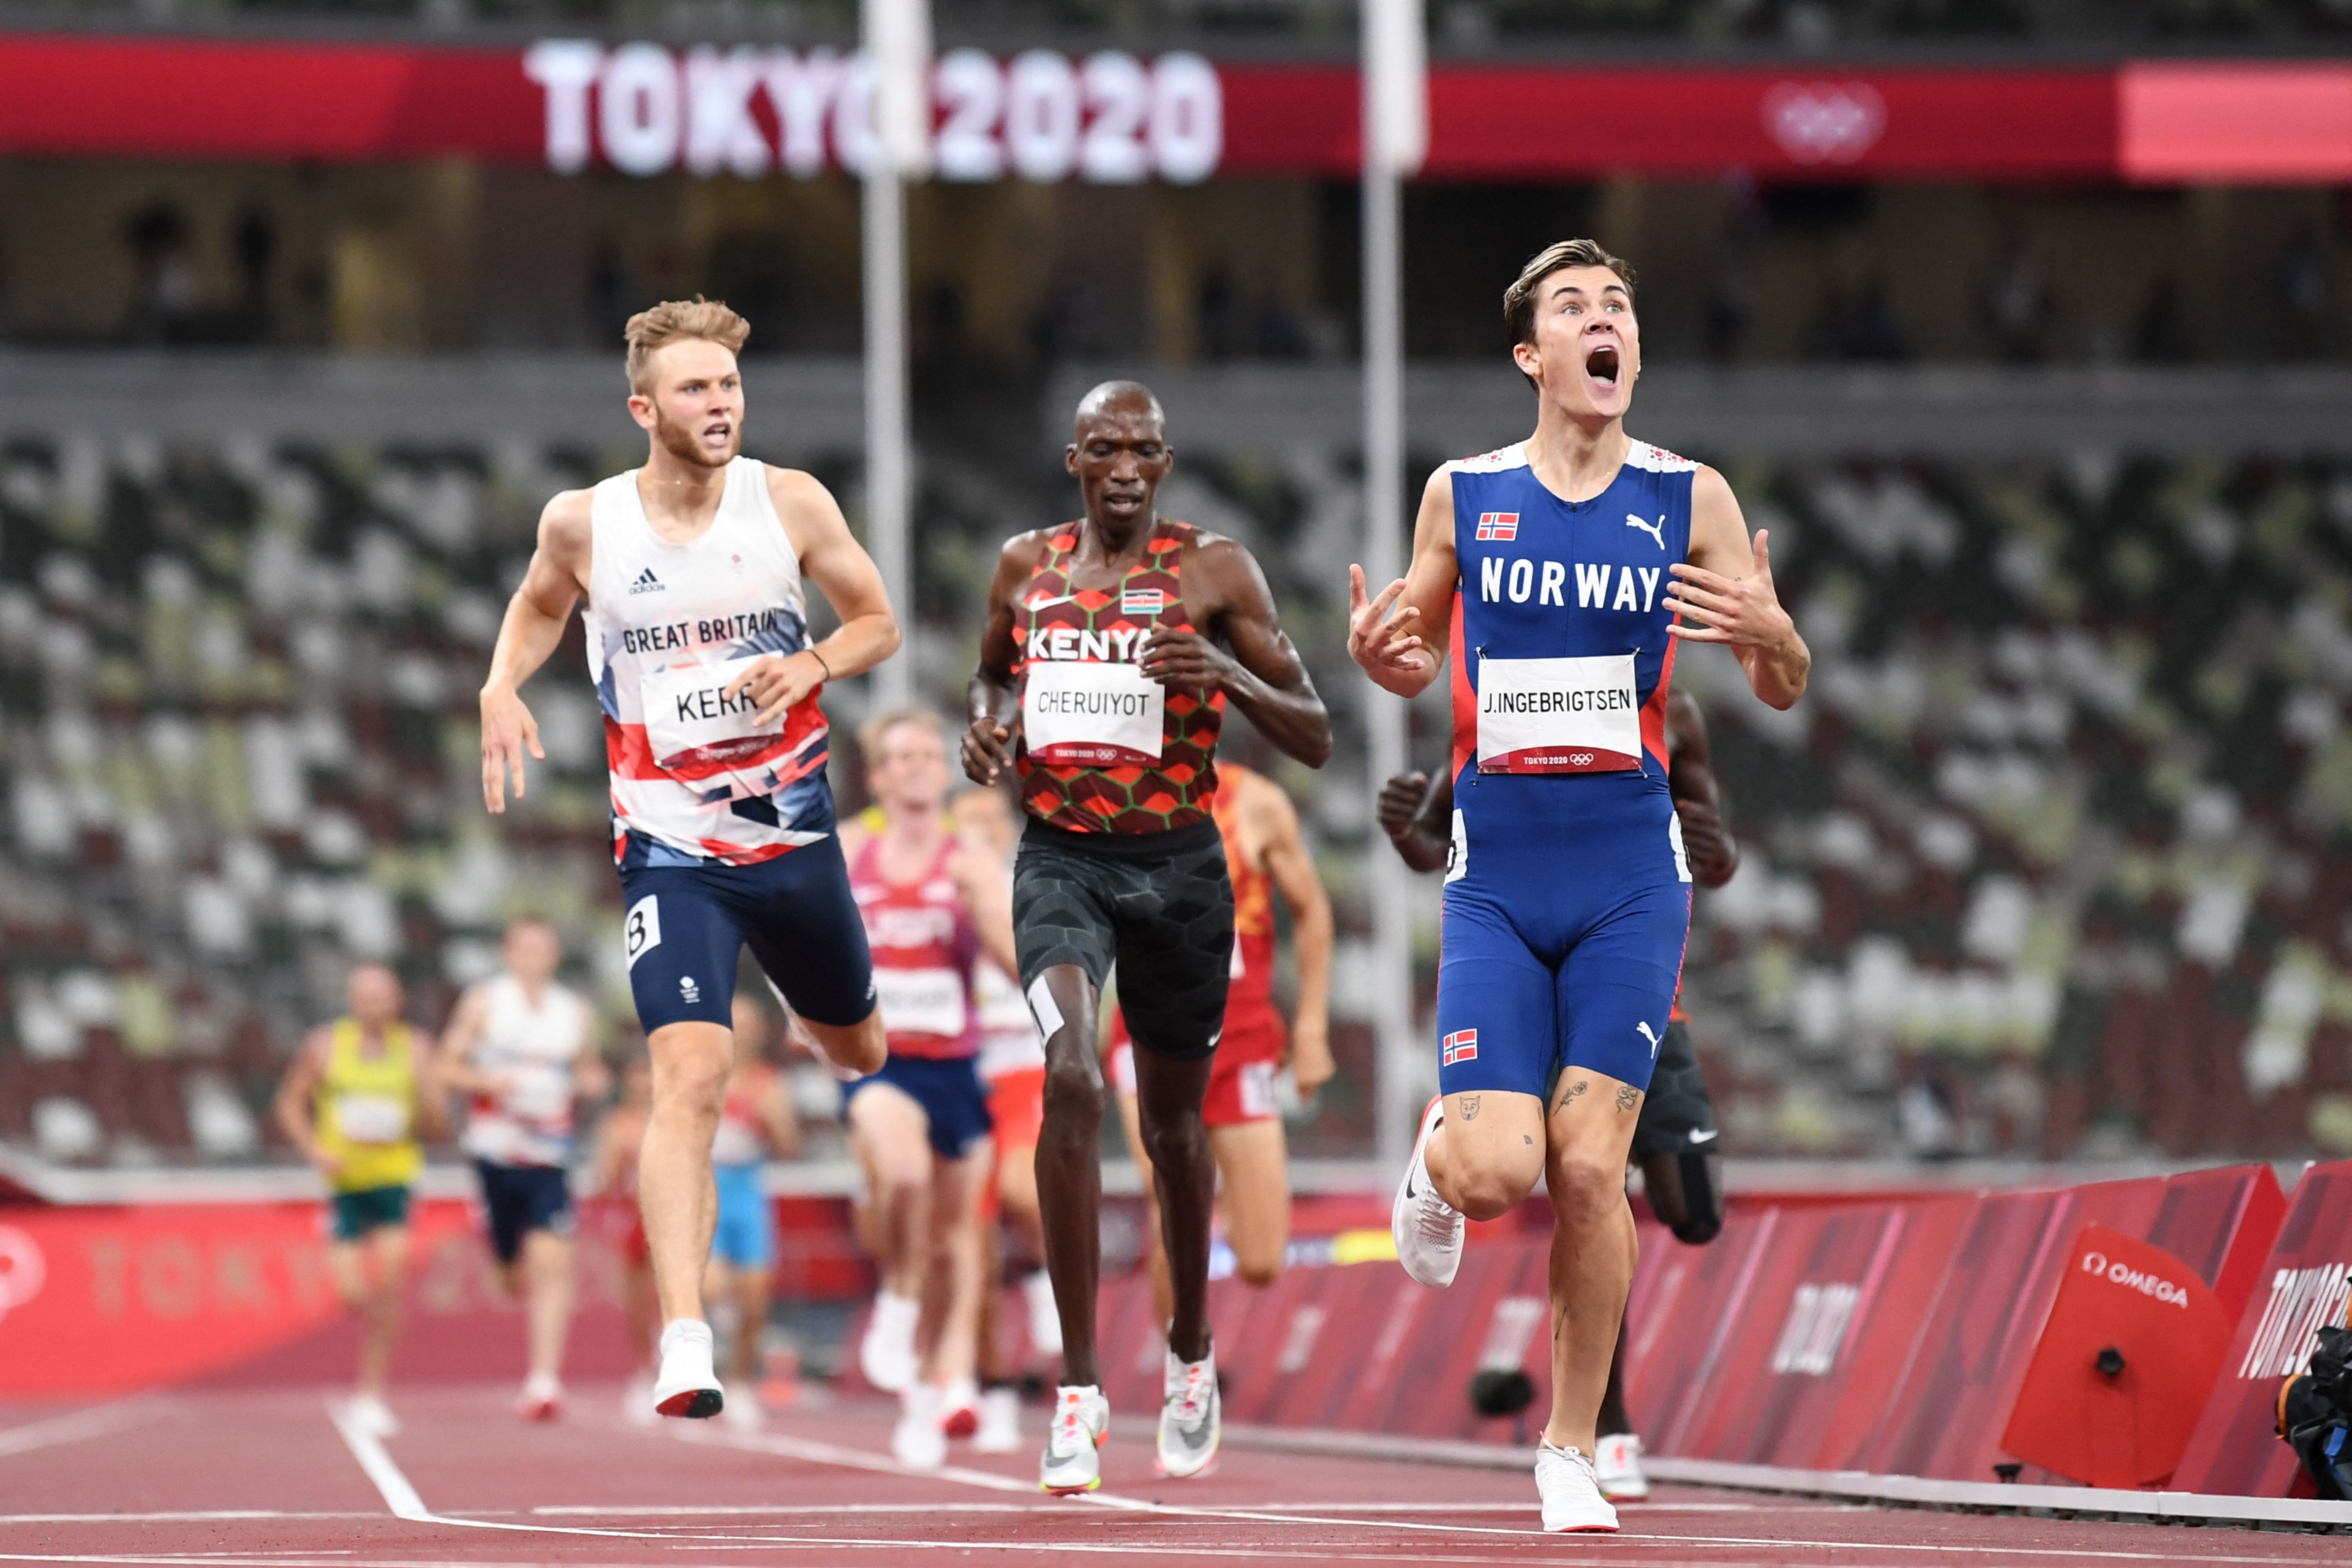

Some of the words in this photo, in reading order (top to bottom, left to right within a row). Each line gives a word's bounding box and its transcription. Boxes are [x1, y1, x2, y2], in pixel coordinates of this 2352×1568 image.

[933, 46, 1224, 184] 2020
[629, 582, 666, 594] adidas
[1482, 557, 1661, 612] NORWAY
[623, 622, 689, 654] GREAT
[698, 608, 778, 643] BRITAIN
[1028, 627, 1157, 661] KENYA
[1038, 691, 1150, 716] CHERUIYOT
[1484, 689, 1631, 713] J.INGEBRIGTSEN
[1523, 757, 1548, 765] TOKYO
[1549, 756, 1568, 765] 2020
[2108, 1262, 2189, 1309] OMEGA
